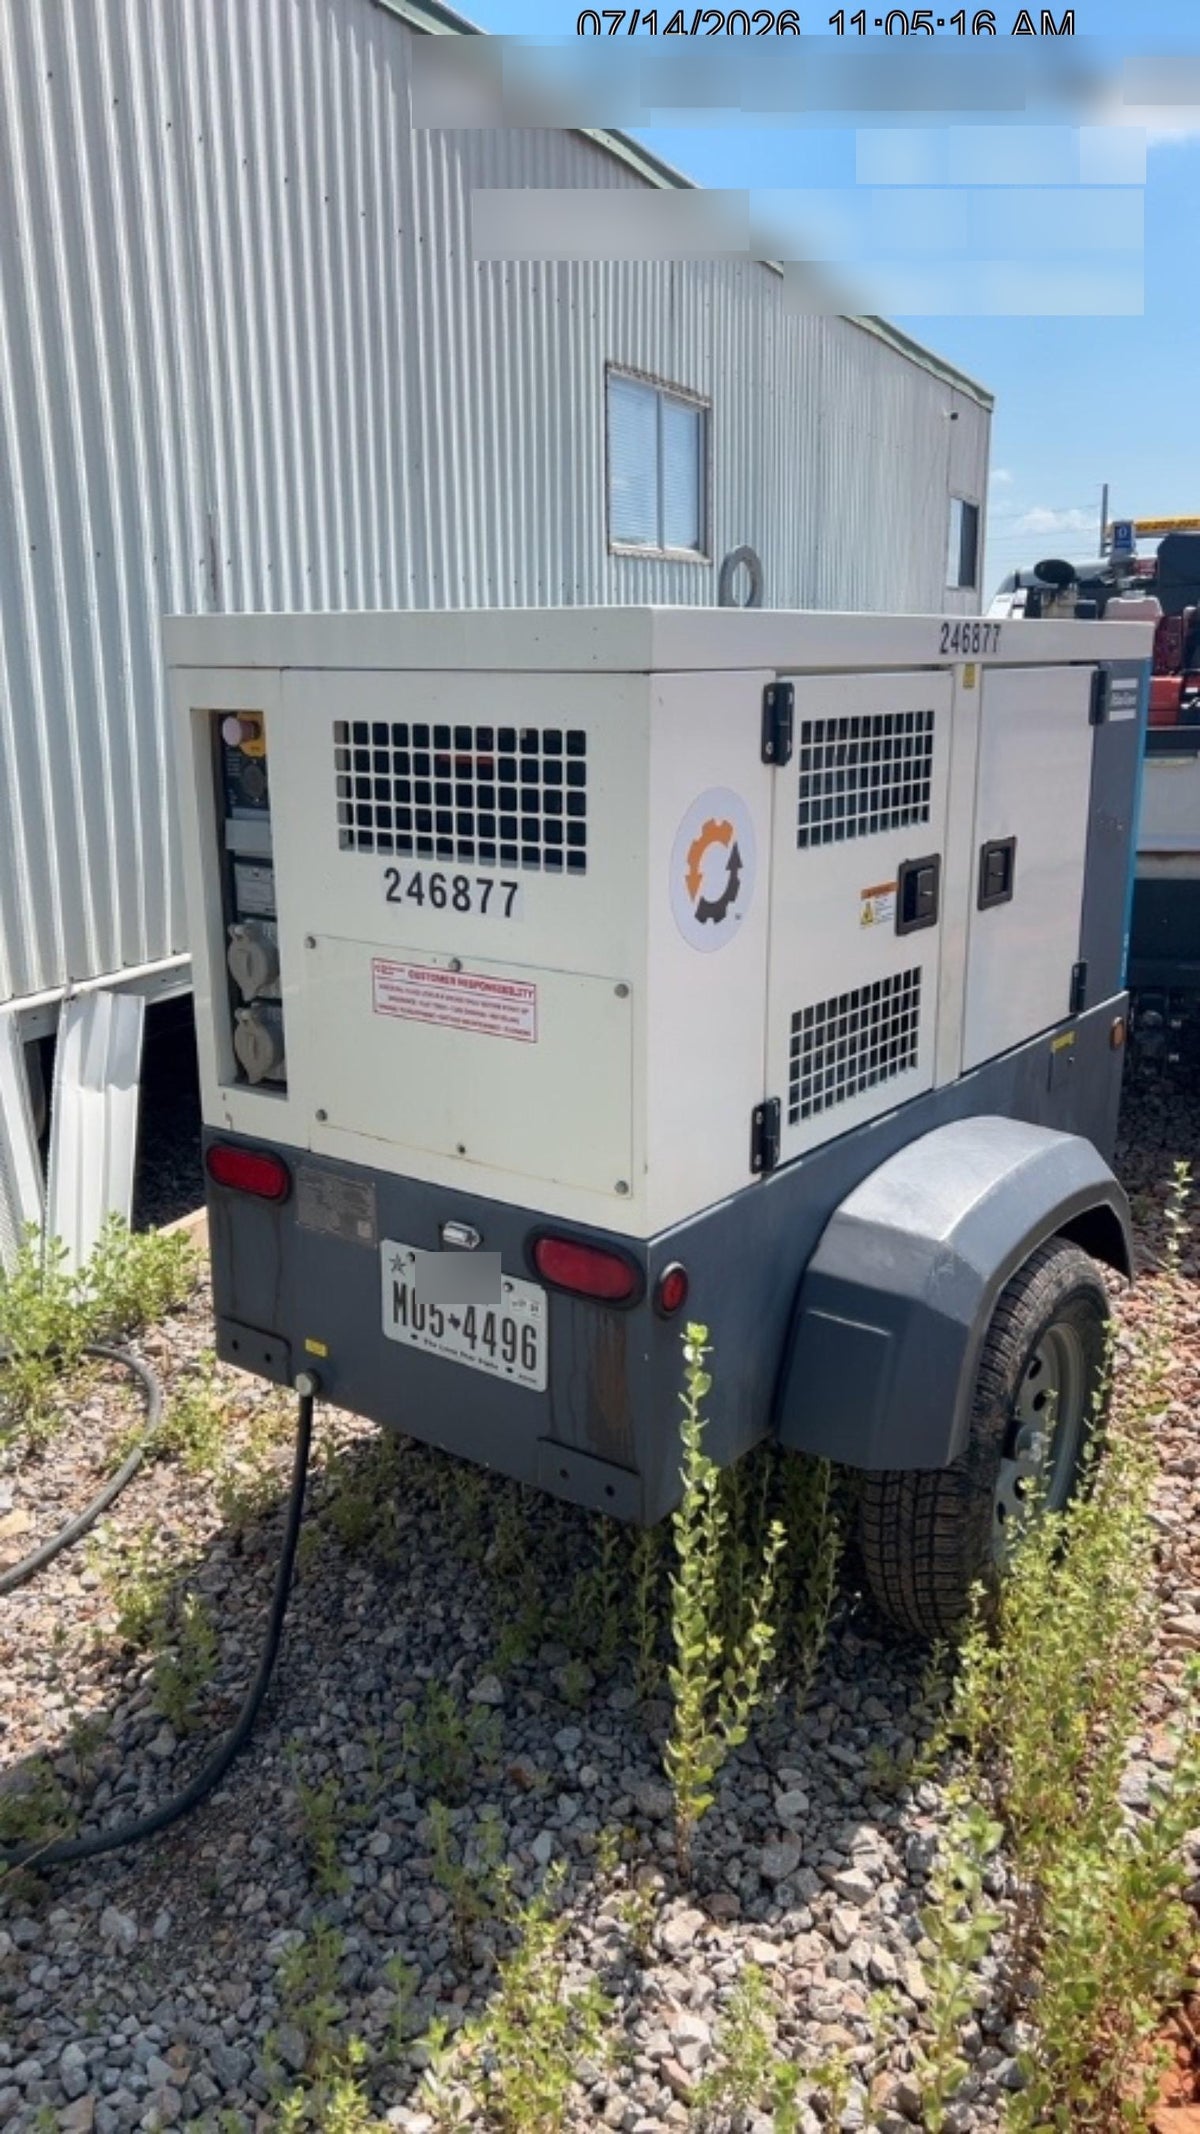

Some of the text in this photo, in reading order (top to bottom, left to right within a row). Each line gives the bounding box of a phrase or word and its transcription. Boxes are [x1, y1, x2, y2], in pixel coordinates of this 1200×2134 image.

[940, 622, 1002, 654] 246877
[384, 867, 518, 918] 246877
[408, 969, 456, 987] CUSTOMER
[457, 976, 534, 999] RESPONSIBILITY
